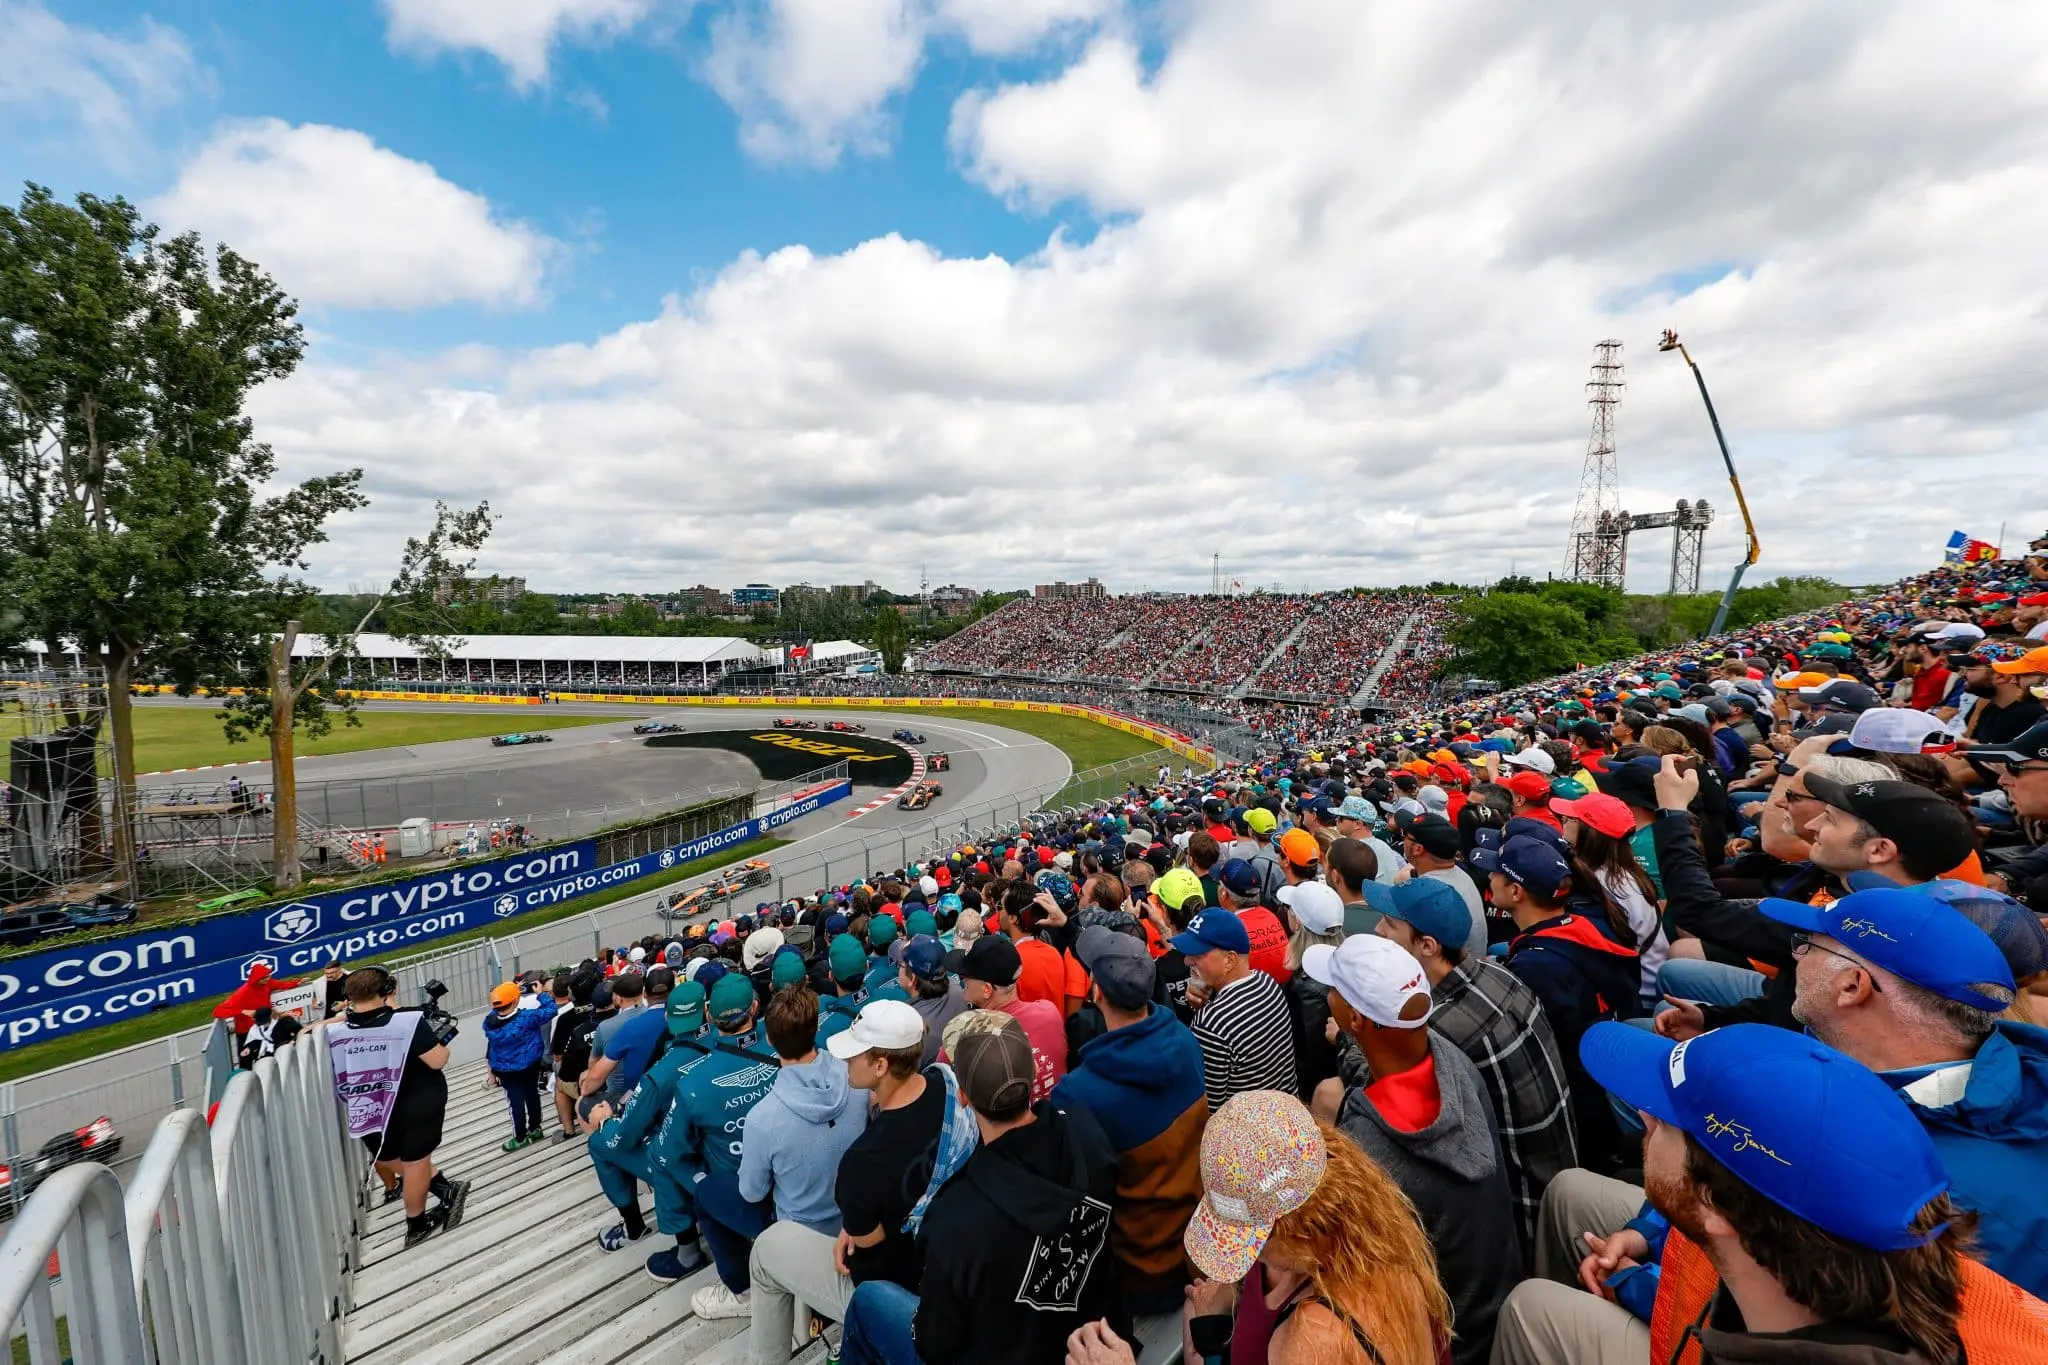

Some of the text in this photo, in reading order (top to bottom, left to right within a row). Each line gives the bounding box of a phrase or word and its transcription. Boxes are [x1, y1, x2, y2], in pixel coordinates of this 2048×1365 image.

[771, 799, 818, 825] crypto.com
[679, 820, 748, 860] crypto.com
[340, 849, 579, 922] crypto.com
[526, 863, 640, 906] crypto.com
[290, 911, 465, 967] crypto.com
[0, 977, 195, 1045] pto.com
[724, 1090, 762, 1110] ASTON
[1055, 1248, 1089, 1301] CREW
